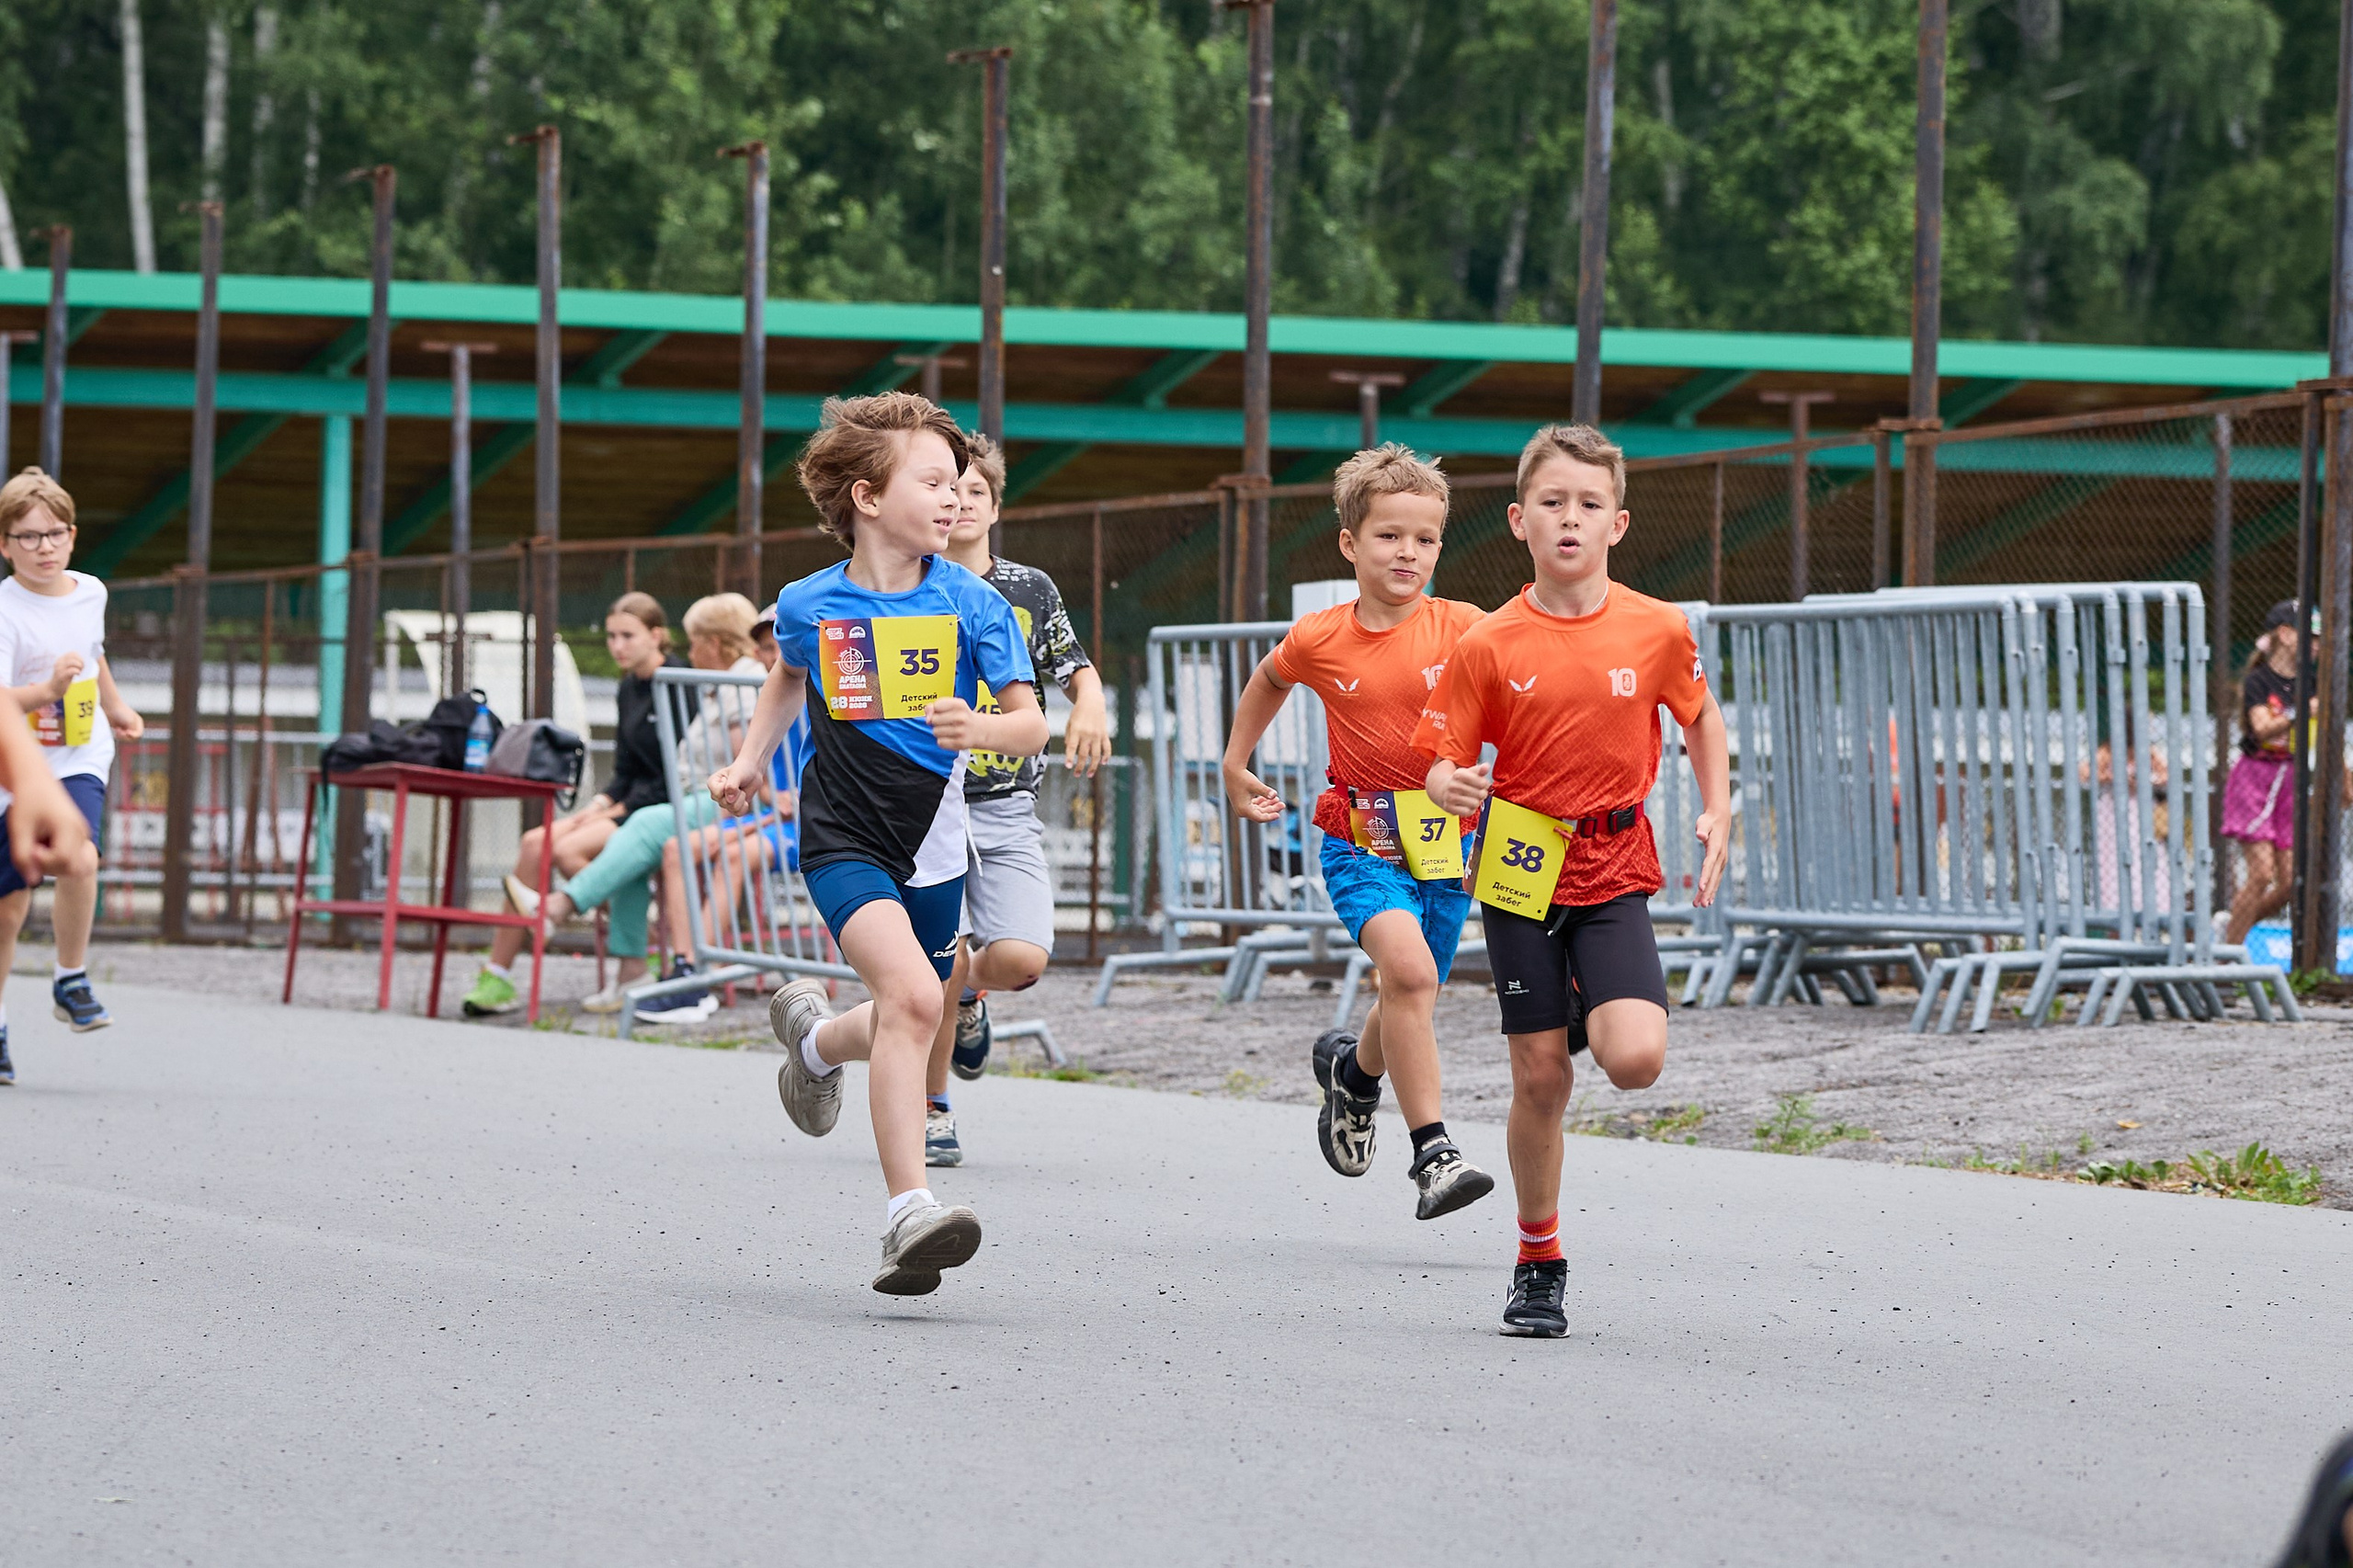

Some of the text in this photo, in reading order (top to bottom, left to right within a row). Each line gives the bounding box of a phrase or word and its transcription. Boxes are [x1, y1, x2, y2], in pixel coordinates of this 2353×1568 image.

[900, 648, 939, 676] 35
[839, 675, 867, 684] АРЕНА
[1608, 667, 1637, 697] 10
[901, 692, 938, 702] Детский
[907, 703, 926, 712] заб
[1420, 817, 1446, 843] 37
[1421, 857, 1449, 867] Детский
[1501, 837, 1545, 873] 38
[1427, 867, 1445, 875] забег
[1492, 881, 1531, 900] Детский
[1495, 893, 1522, 907] забег
